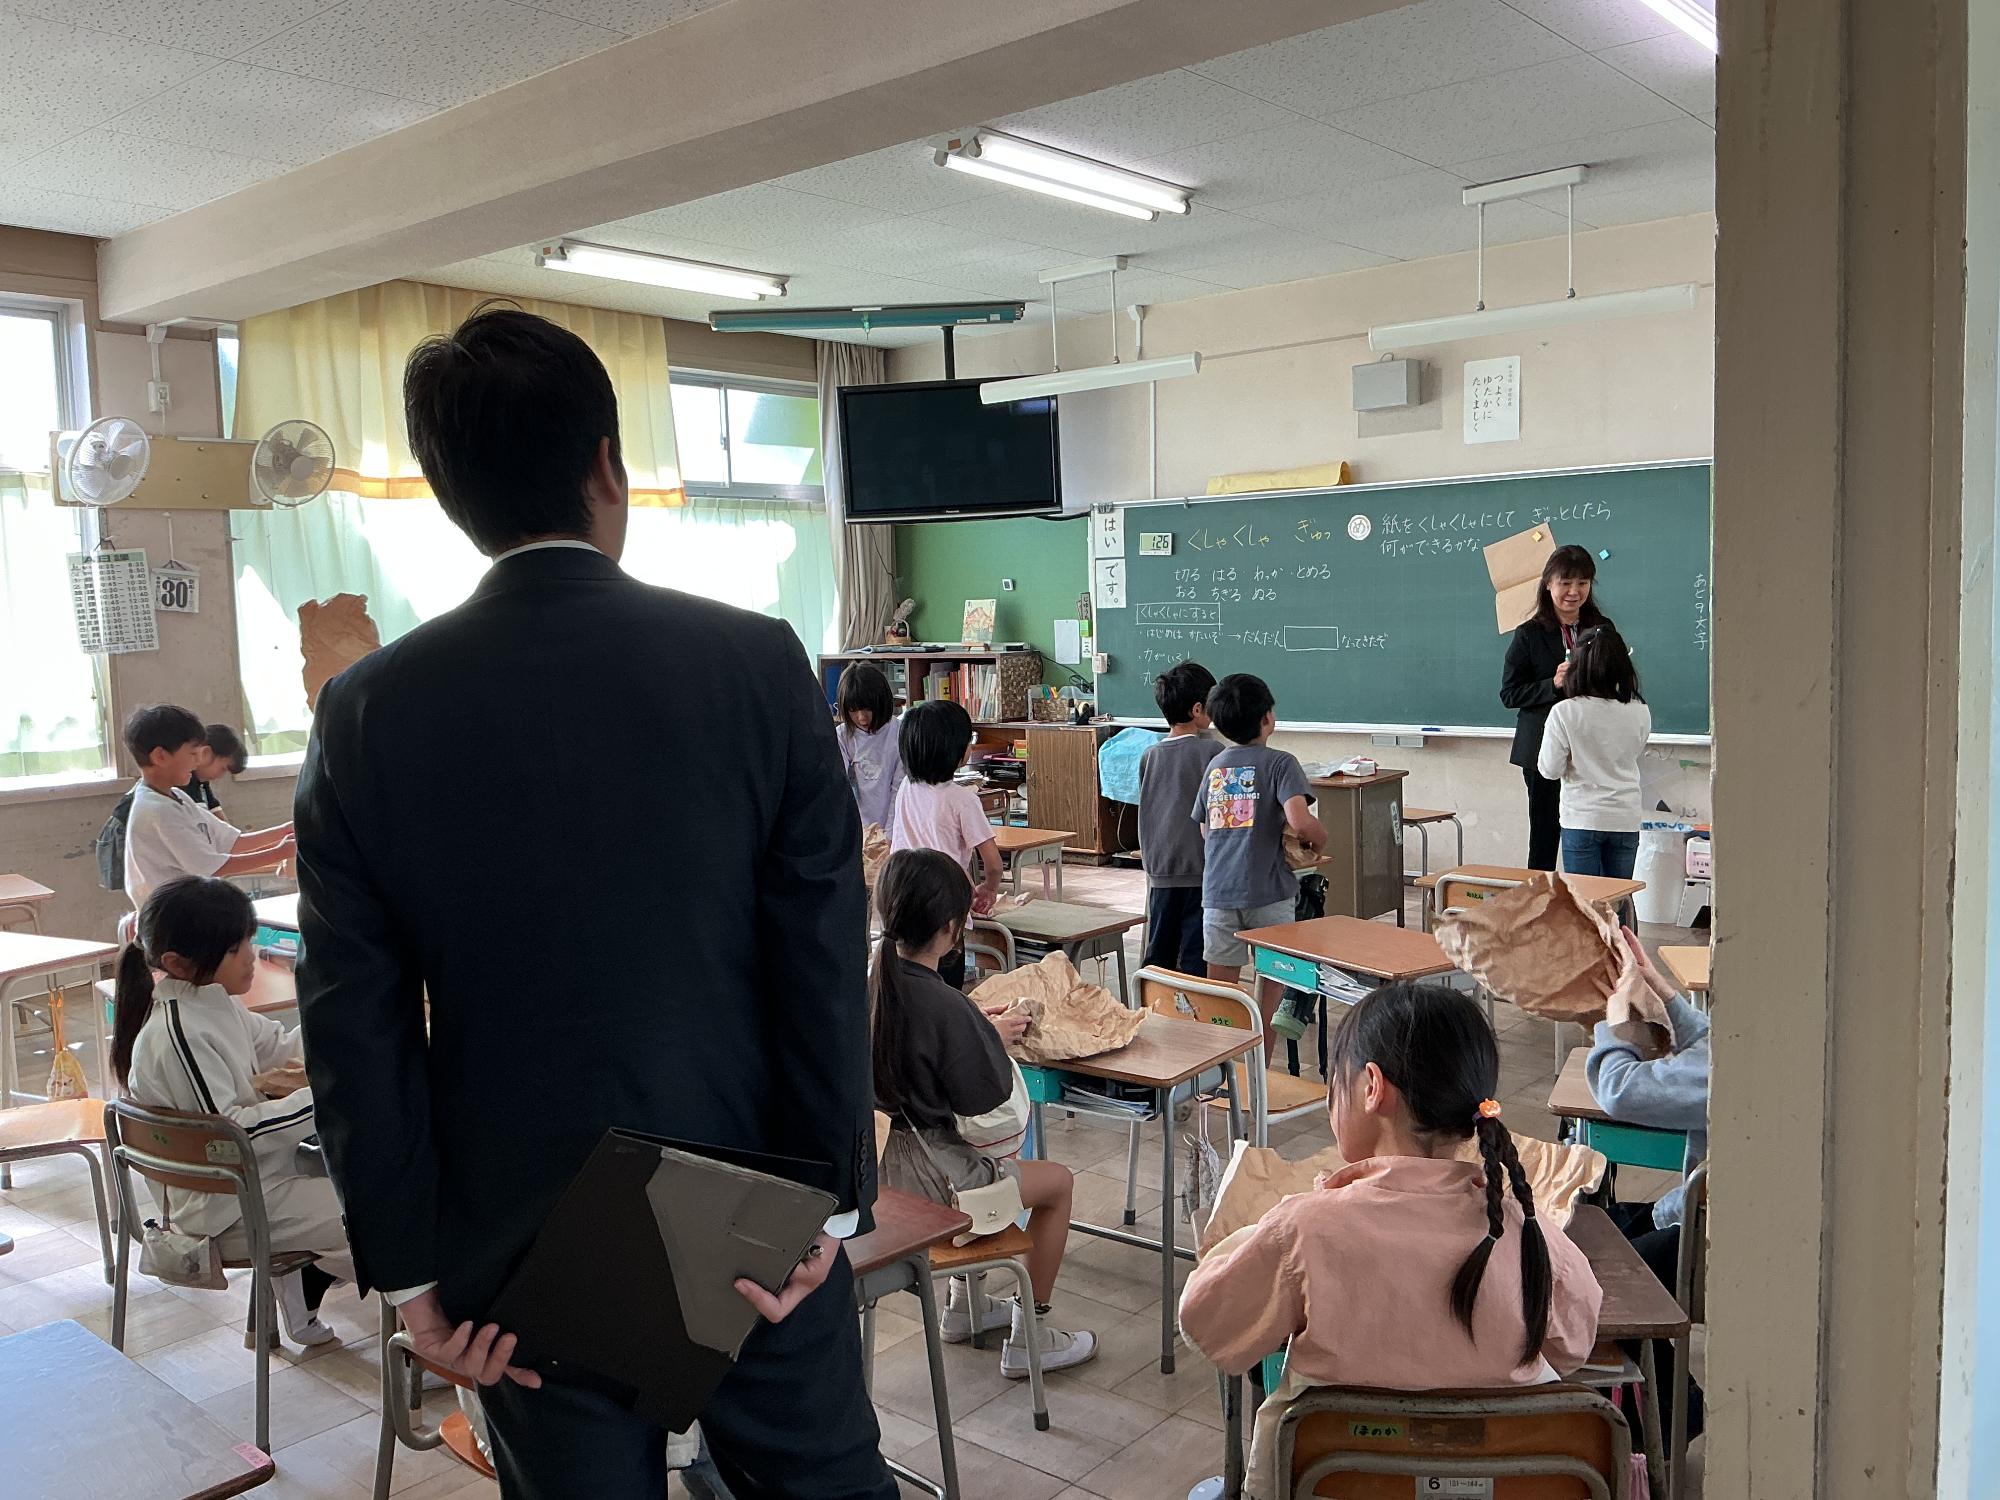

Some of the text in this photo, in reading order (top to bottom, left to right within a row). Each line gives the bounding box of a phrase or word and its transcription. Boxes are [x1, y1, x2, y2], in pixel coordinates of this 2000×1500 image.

[1472, 376, 1481, 433] たくましく
[1483, 375, 1493, 420] ゆたかに
[1494, 374, 1504, 407] つよく
[1104, 517, 1117, 549] はい
[1188, 524, 1271, 551] くしゃくしゃ
[161, 579, 188, 608] 30
[1105, 562, 1119, 604] です。
[1353, 1423, 1398, 1436] ほのか
[1428, 1477, 1441, 1490] 6
